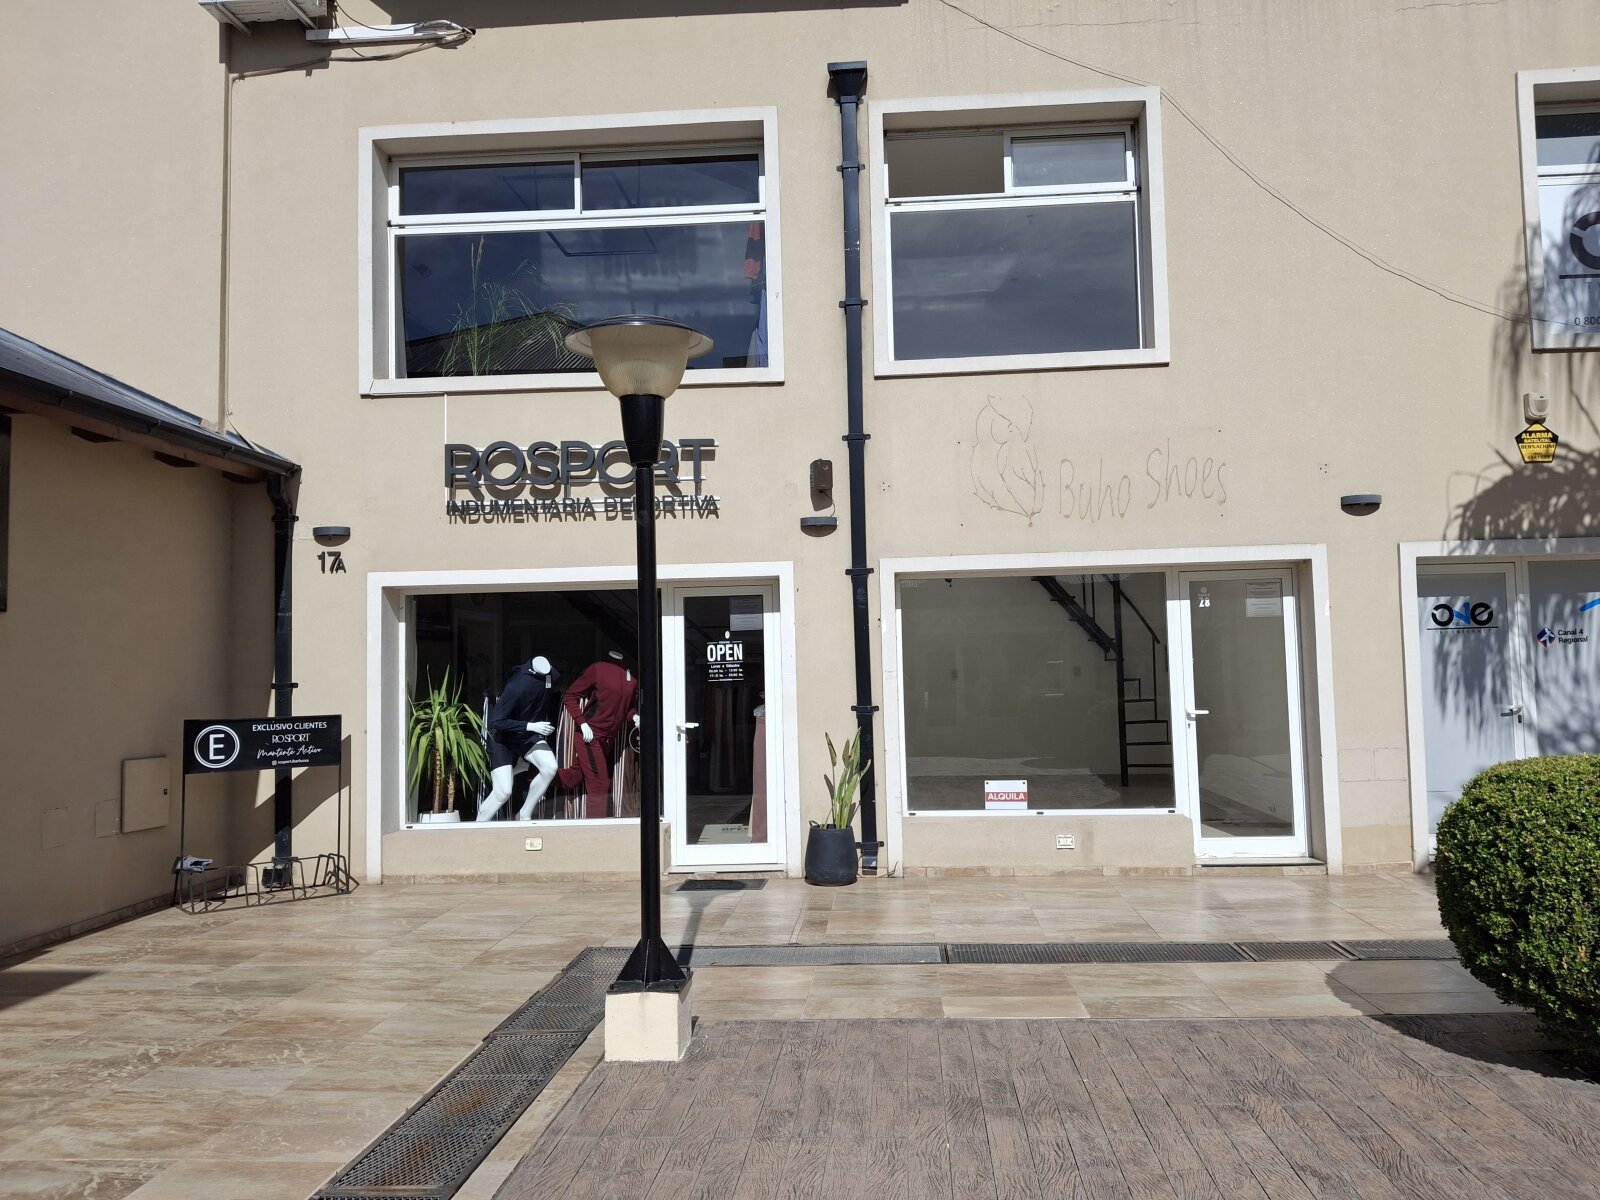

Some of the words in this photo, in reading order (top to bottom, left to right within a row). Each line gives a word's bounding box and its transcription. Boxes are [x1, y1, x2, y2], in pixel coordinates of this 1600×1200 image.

[445, 439, 715, 488] ROSPORT
[1147, 438, 1227, 509] Shoes
[446, 497, 595, 516] INDUMENTARIA
[604, 495, 718, 512] DERTIVA
[1558, 636, 1588, 644] Regional
[707, 643, 743, 662] OPEN
[294, 721, 328, 730] CLIENTES
[208, 733, 226, 760] E
[272, 733, 311, 743] ROSPORT
[987, 792, 1025, 801] ALQUILA
